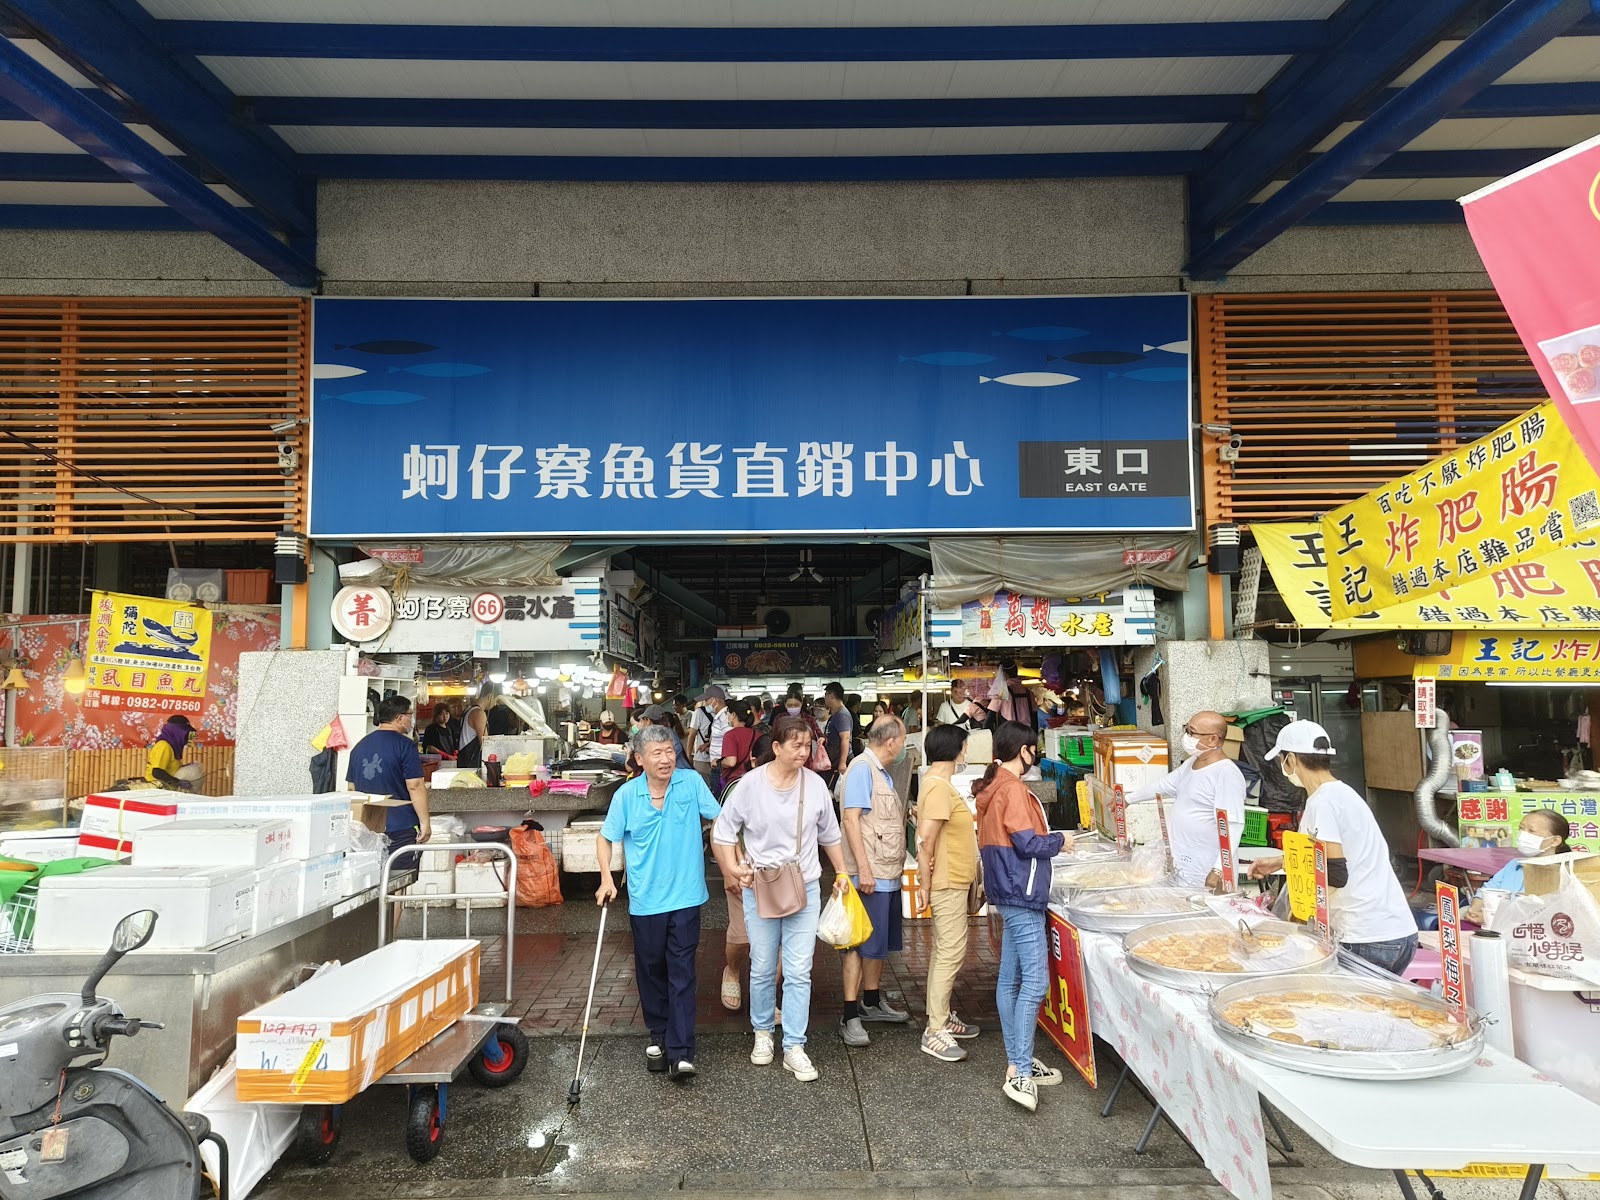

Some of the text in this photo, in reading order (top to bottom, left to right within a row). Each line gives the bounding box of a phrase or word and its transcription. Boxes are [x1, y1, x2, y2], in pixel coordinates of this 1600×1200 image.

[402, 440, 985, 500] 蚵仔寮魚貨直銷中心
[1064, 447, 1149, 476] 東口
[1376, 411, 1546, 515] 百吃不厭炸肥腸
[1065, 482, 1147, 492] EAST GATE
[1384, 450, 1560, 568] 炸肥腸
[1337, 513, 1374, 605] 王記
[347, 593, 376, 626] 菁
[396, 595, 471, 620] 蚵仔寮
[477, 599, 497, 616] 66
[121, 605, 139, 636] 彌陀
[1060, 612, 1113, 636] 水產
[728, 656, 739, 667] 48
[1474, 636, 1600, 662] 王記炸
[102, 668, 202, 693] 虱目魚丸
[714, 667, 726, 675] 48
[126, 696, 202, 712] 0982-078560
[1417, 686, 1427, 727] 請取票
[1459, 796, 1509, 820] 感謝
[1528, 940, 1584, 961] 小時候
